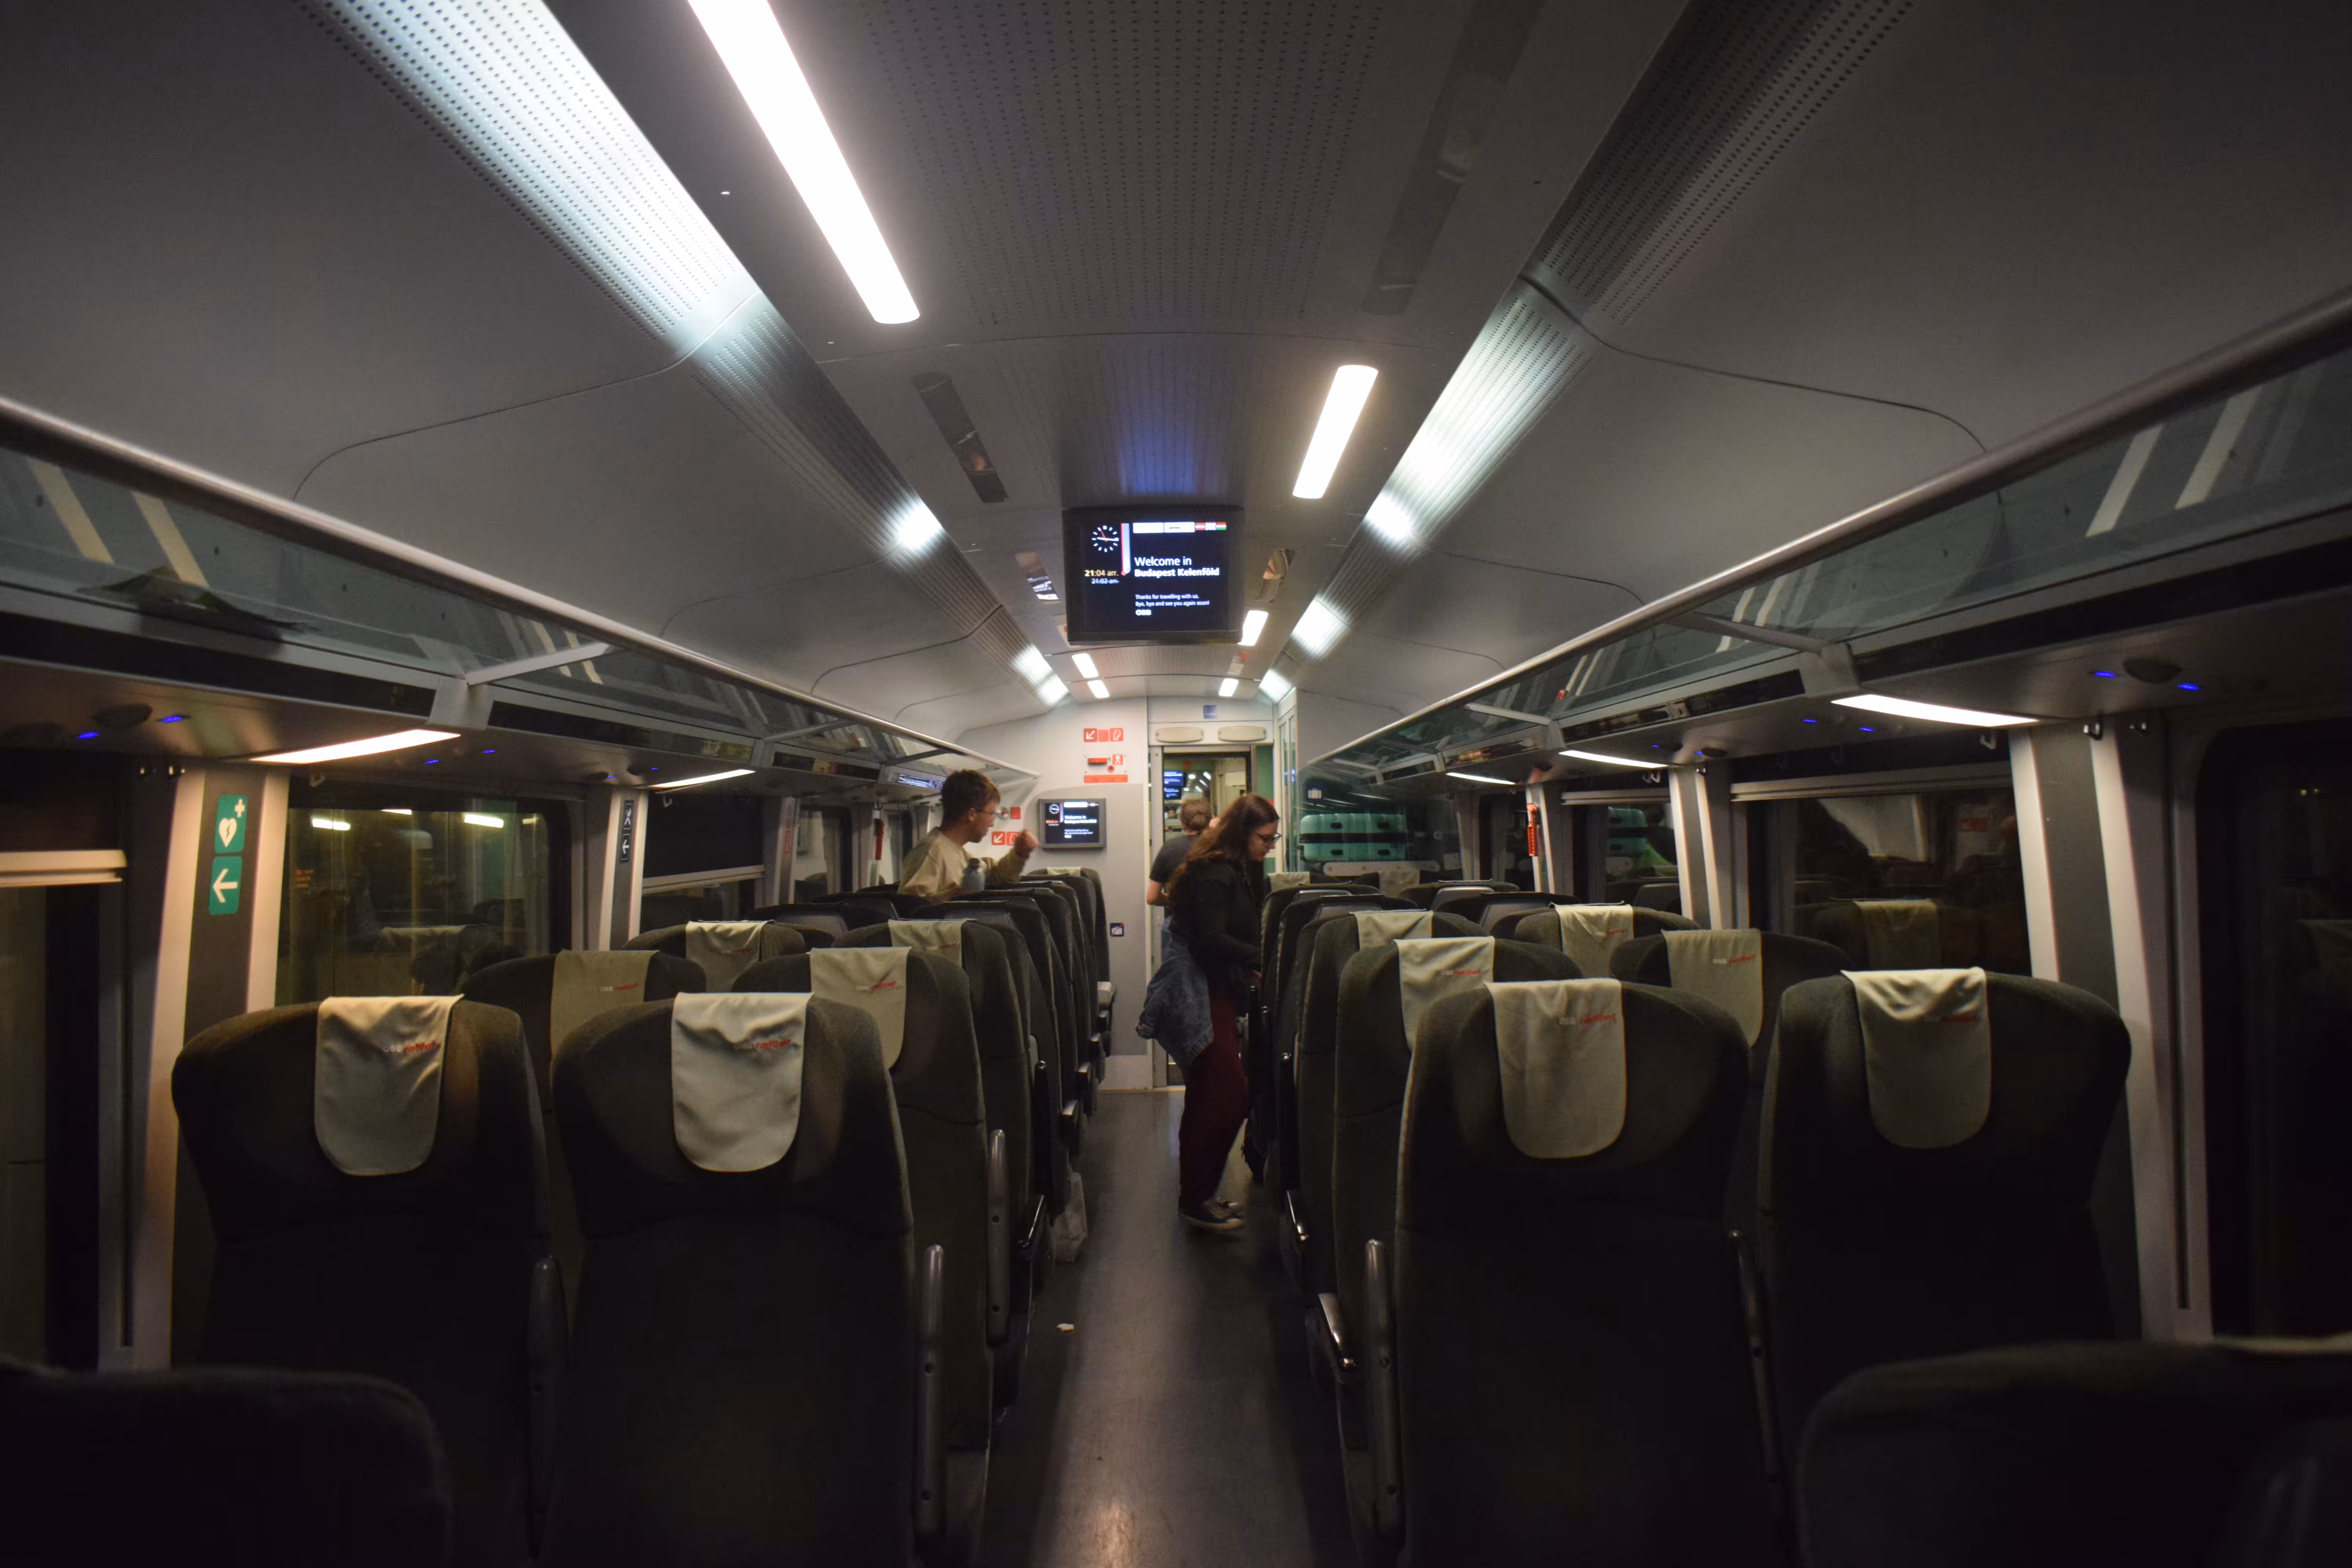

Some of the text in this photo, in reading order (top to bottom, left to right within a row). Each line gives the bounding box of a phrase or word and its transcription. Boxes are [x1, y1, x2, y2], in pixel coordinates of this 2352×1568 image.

[1134, 556, 1192, 566] Welcome in
[1134, 567, 1220, 578] Budapest Kelenföld
